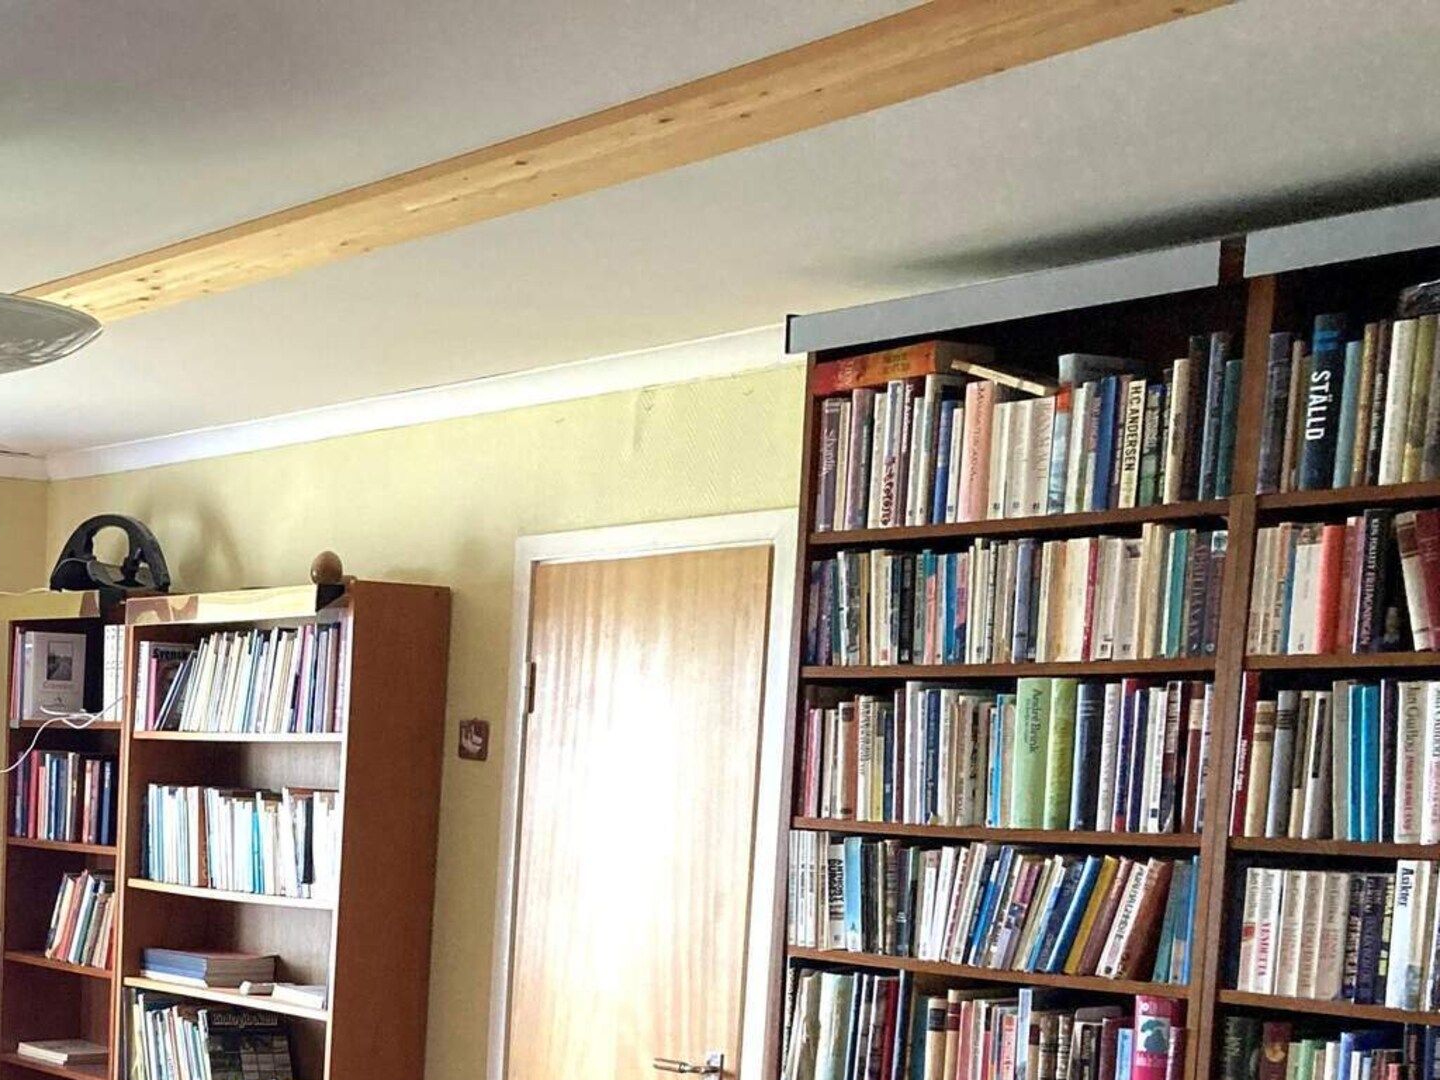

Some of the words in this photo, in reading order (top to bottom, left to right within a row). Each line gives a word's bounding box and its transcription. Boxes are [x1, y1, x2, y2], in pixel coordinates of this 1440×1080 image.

[1305, 370, 1333, 441] STÄLLD
[1124, 408, 1140, 472] ANDERSEN
[1404, 706, 1419, 753] Guillou
[1258, 922, 1272, 977] VENDETTA
